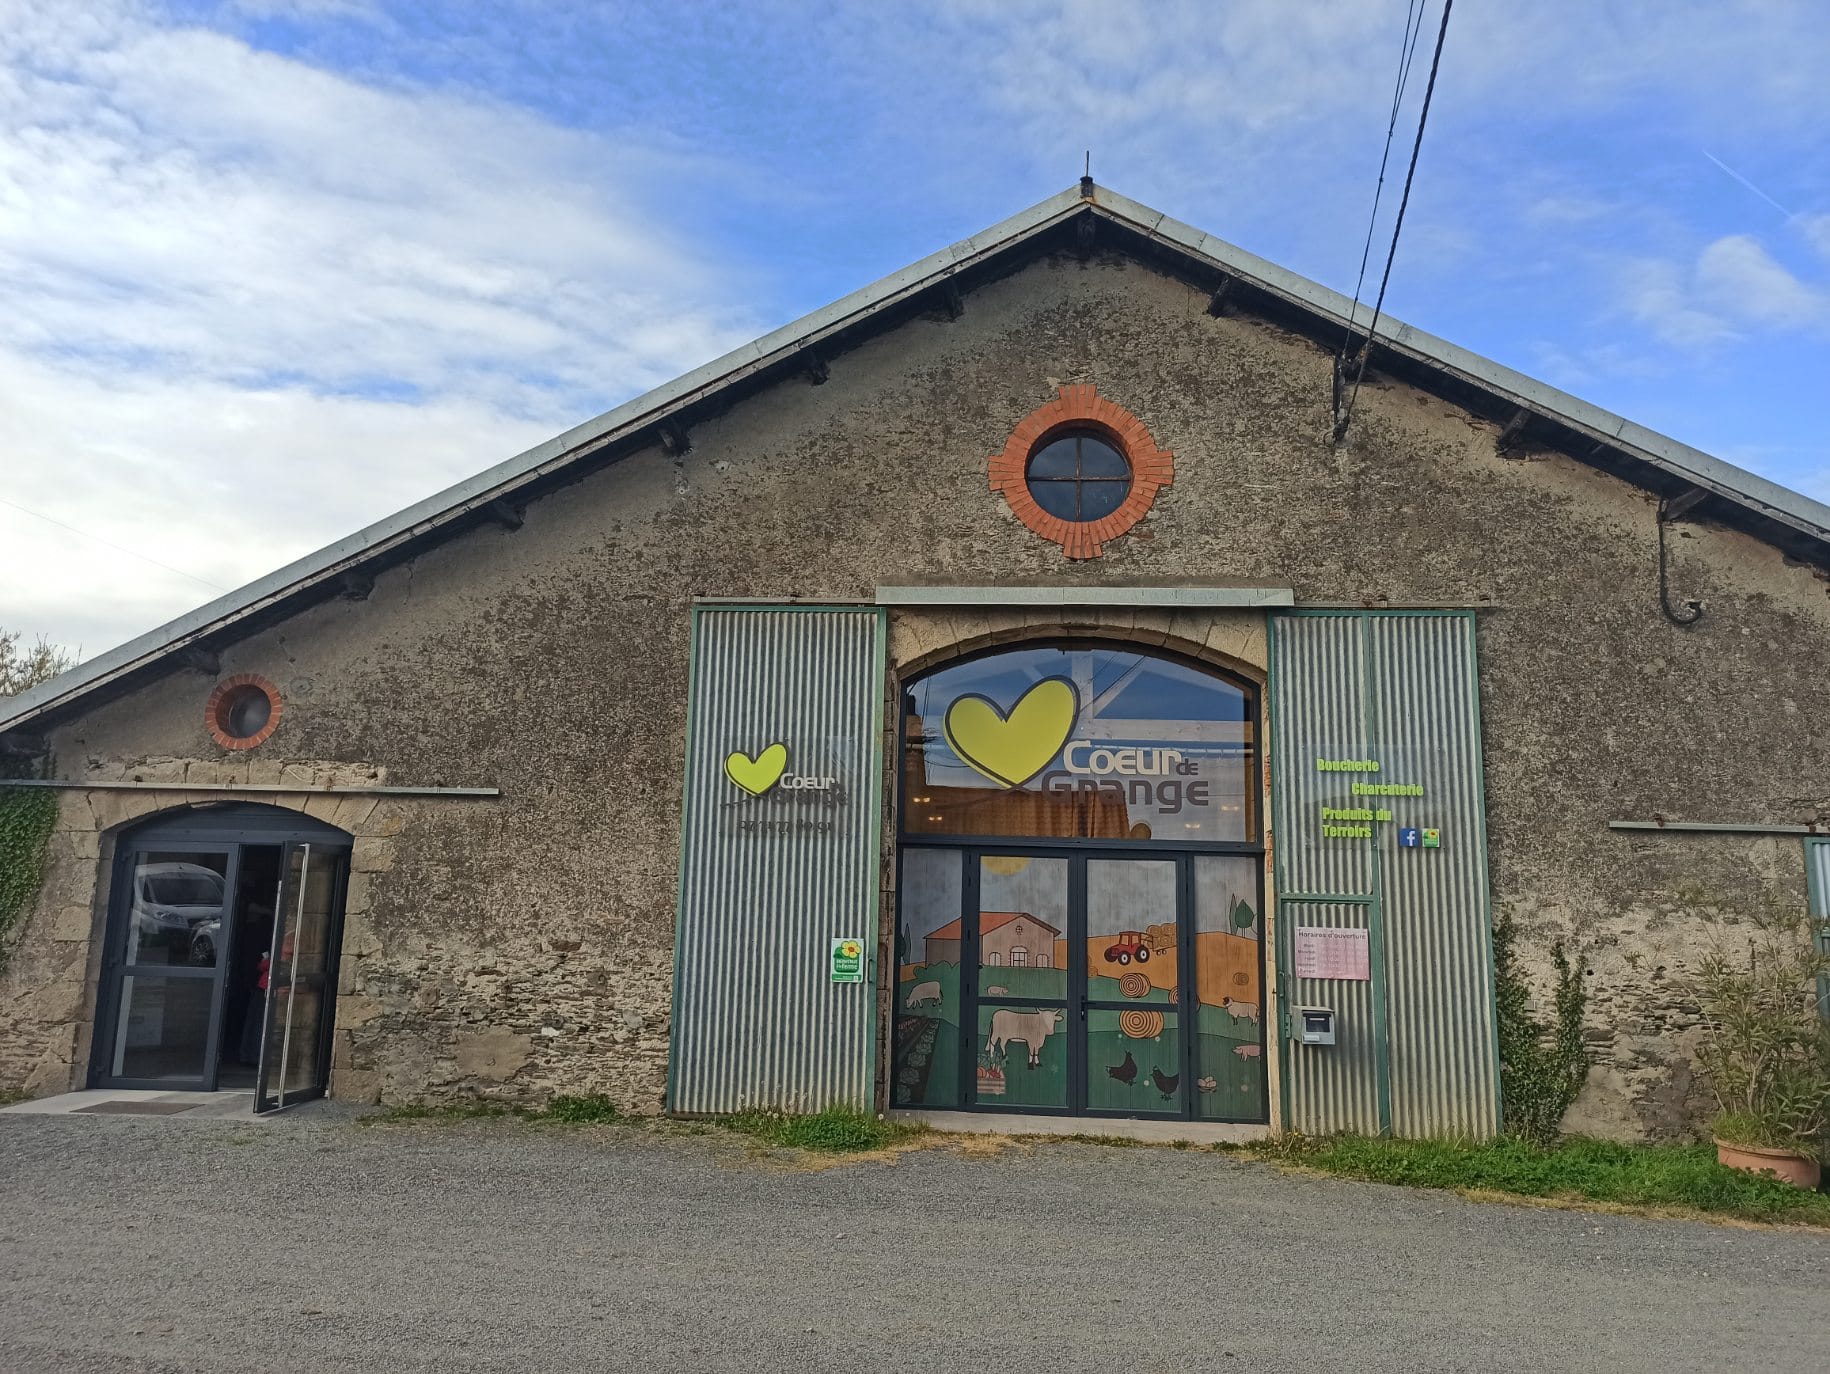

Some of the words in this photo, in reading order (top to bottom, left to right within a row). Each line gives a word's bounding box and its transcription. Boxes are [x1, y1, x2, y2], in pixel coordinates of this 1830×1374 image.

[1063, 740, 1182, 775] Coeur
[1175, 758, 1199, 776] de
[1317, 758, 1379, 771] Boucherie
[780, 772, 834, 789] Coeur
[1041, 770, 1209, 815] Grange
[1322, 807, 1373, 821] Produits
[1375, 808, 1392, 821] du
[1323, 825, 1372, 838] Terroirs
